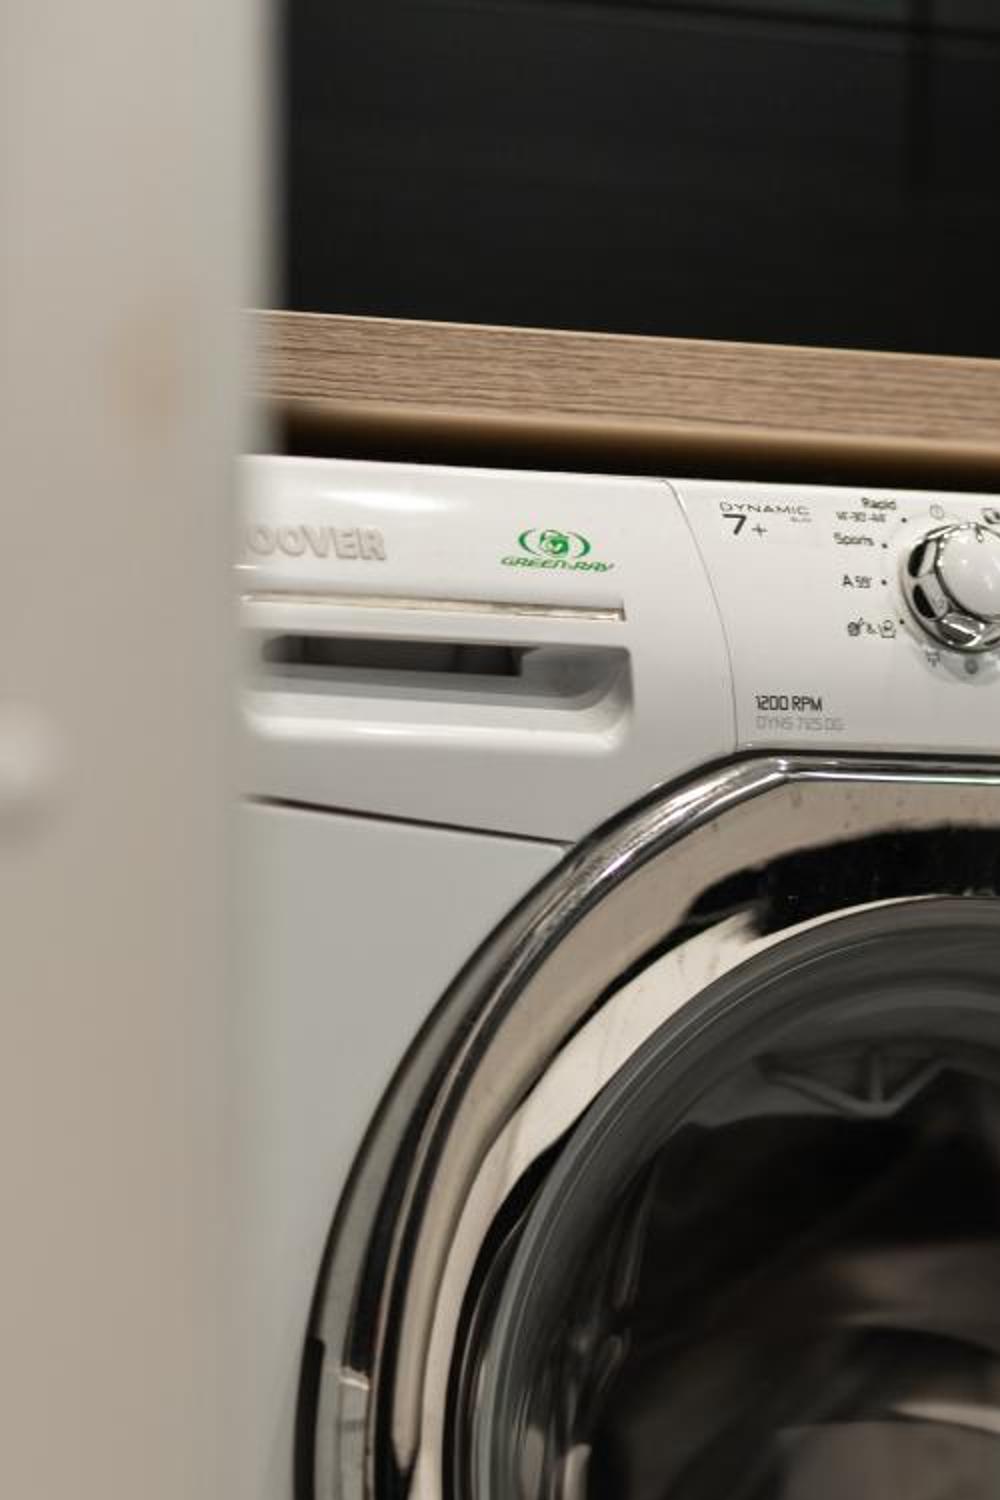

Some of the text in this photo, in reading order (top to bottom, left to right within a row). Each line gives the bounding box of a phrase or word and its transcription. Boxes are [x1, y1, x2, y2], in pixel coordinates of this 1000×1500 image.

[719, 501, 811, 515] DYNAMIC
[243, 525, 386, 561] OOVER
[755, 695, 822, 712] 1200 RPM
